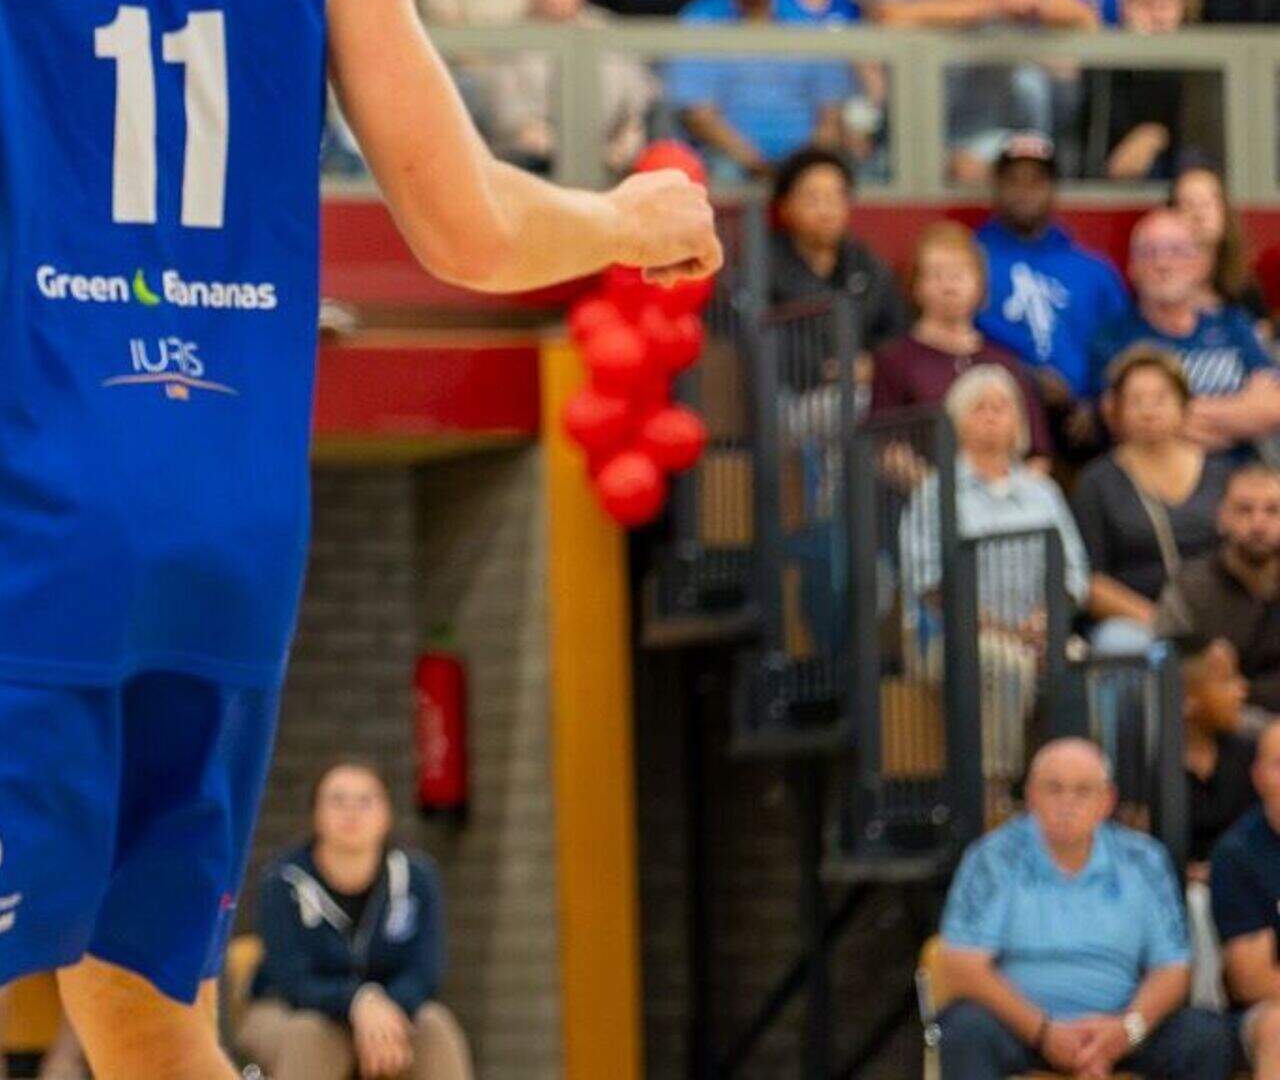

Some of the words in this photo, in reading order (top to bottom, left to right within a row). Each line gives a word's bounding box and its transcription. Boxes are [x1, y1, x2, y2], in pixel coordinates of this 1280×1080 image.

[94, 5, 228, 229] 11
[36, 265, 128, 304] Green
[163, 276, 278, 310] Bananas
